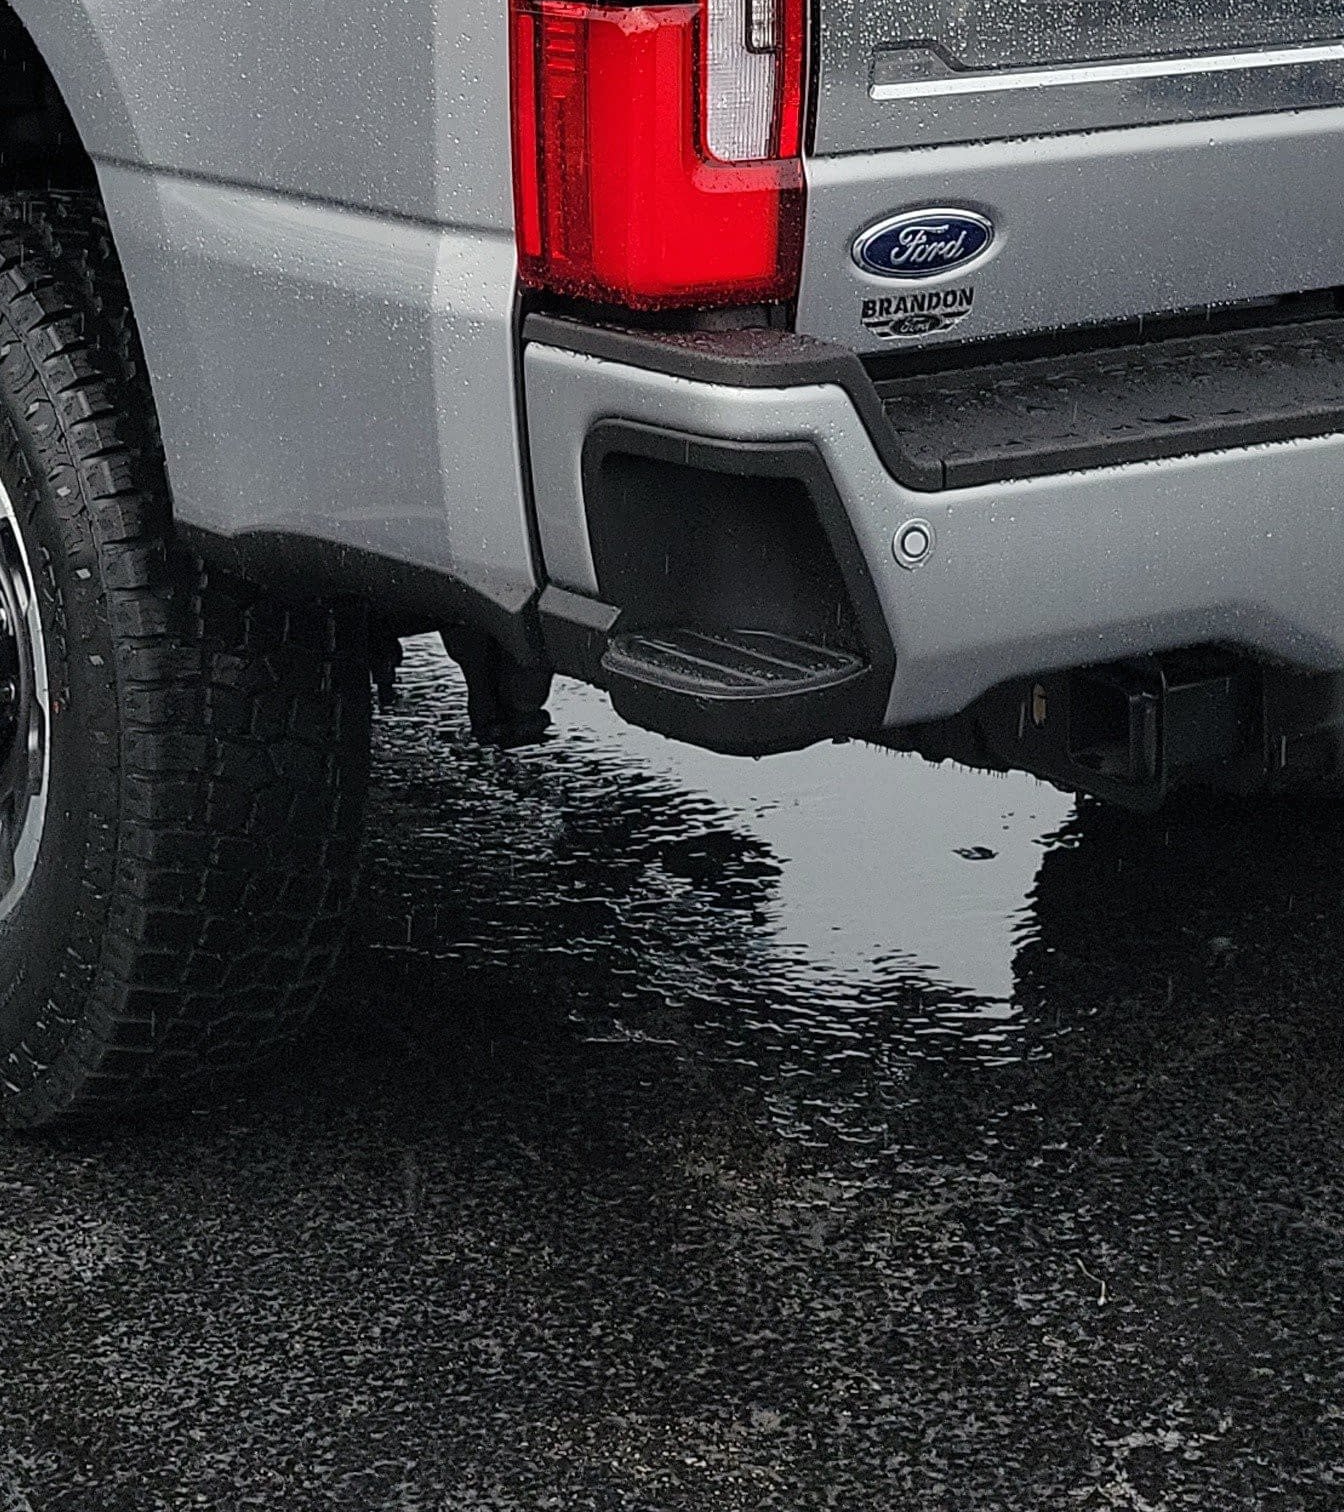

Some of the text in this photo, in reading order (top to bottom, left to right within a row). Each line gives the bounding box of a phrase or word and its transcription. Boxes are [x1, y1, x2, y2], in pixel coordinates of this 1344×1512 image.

[889, 223, 968, 266] Ford
[860, 286, 975, 319] BRANDON
[899, 315, 931, 333] Ford
